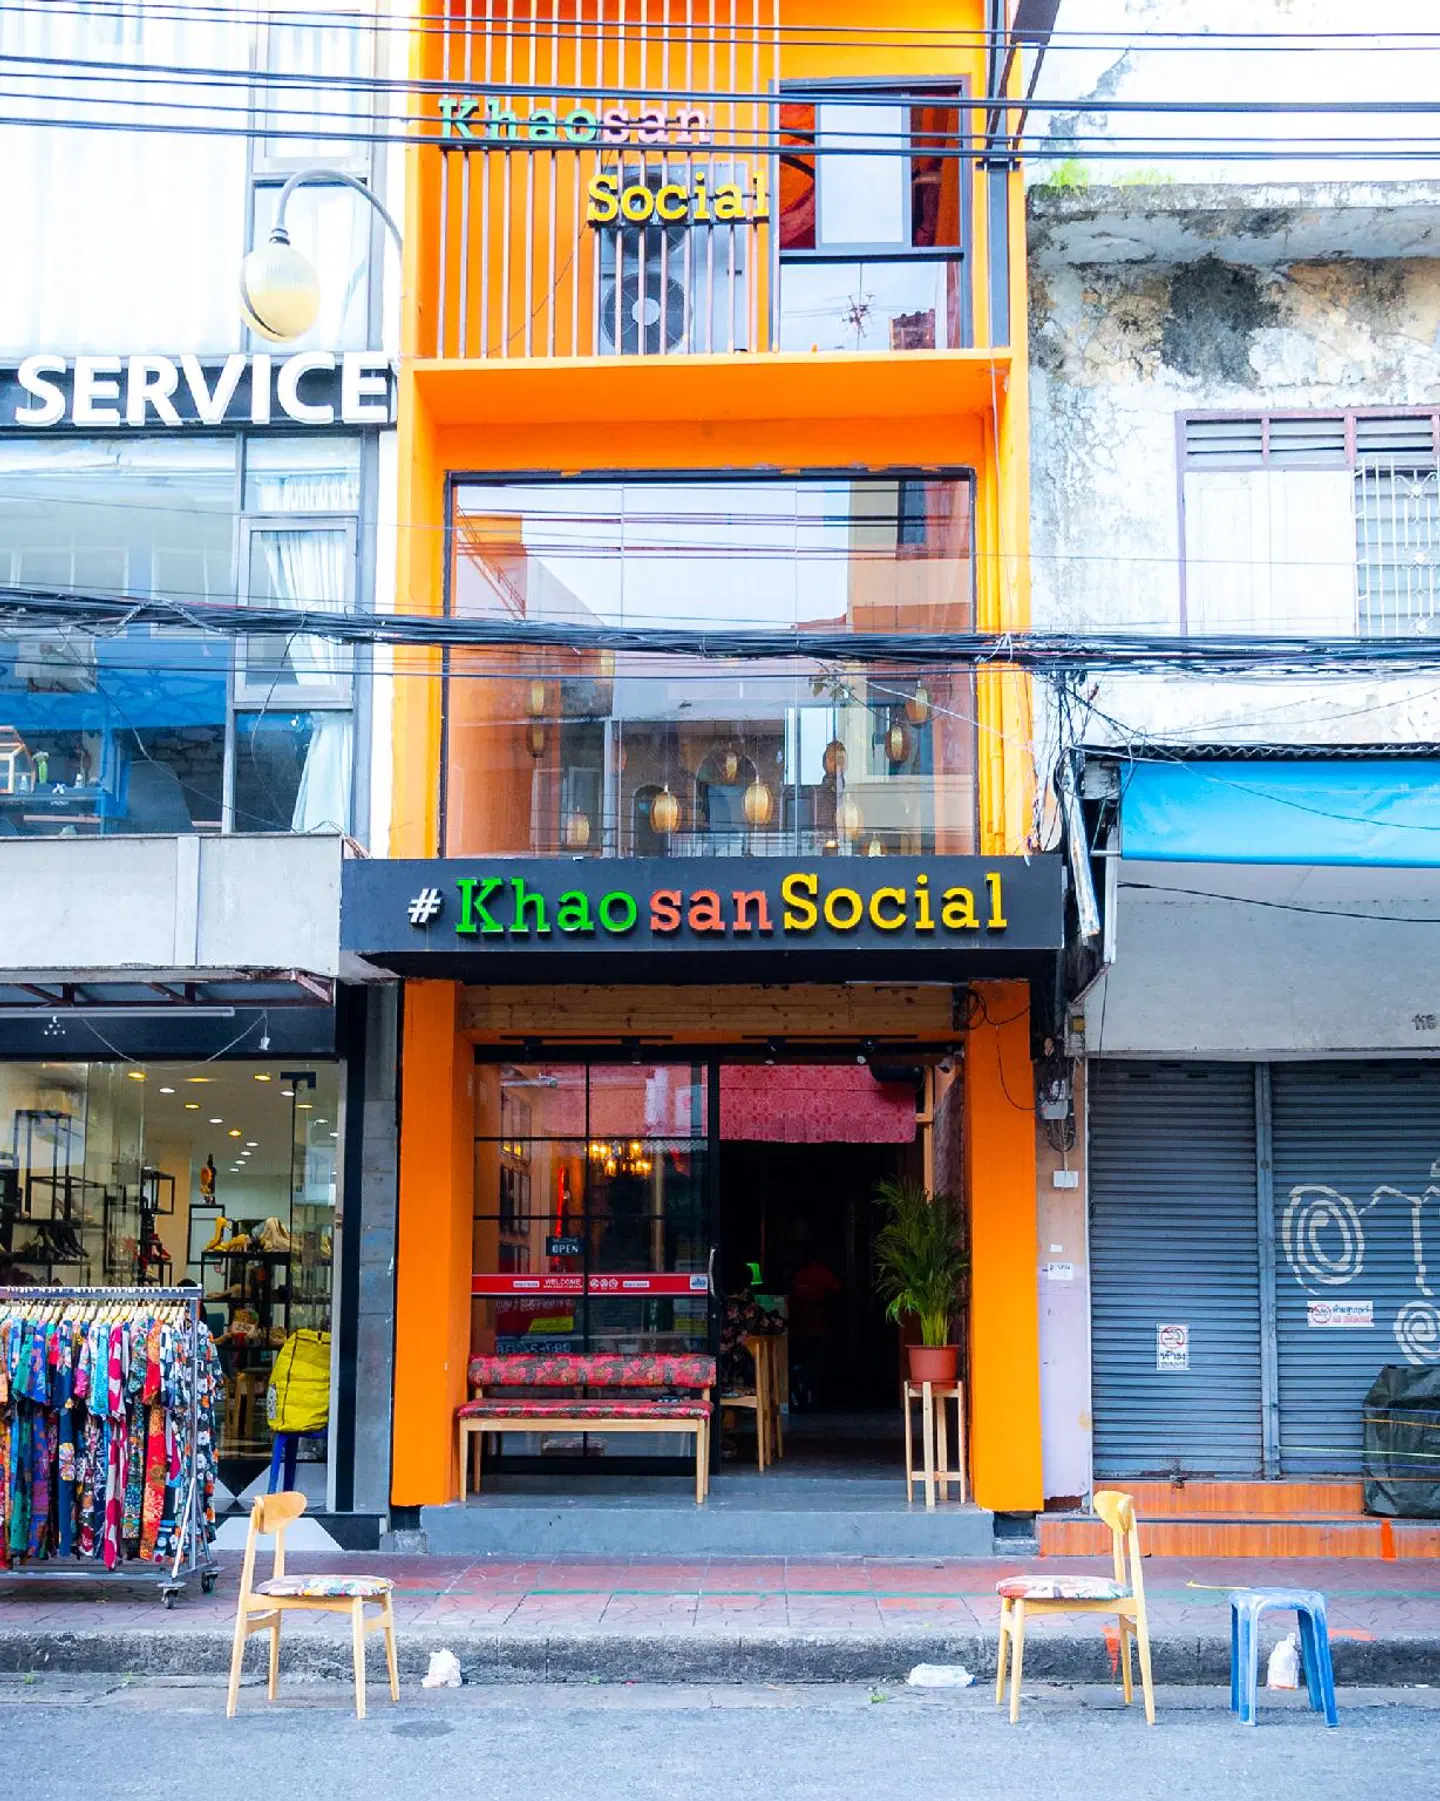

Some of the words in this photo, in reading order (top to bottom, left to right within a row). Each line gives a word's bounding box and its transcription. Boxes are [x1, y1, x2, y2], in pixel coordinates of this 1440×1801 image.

[438, 98, 711, 144] Khaosan
[588, 171, 769, 222] Social
[15, 351, 390, 427] SERVICE
[552, 1244, 579, 1254] OPEN
